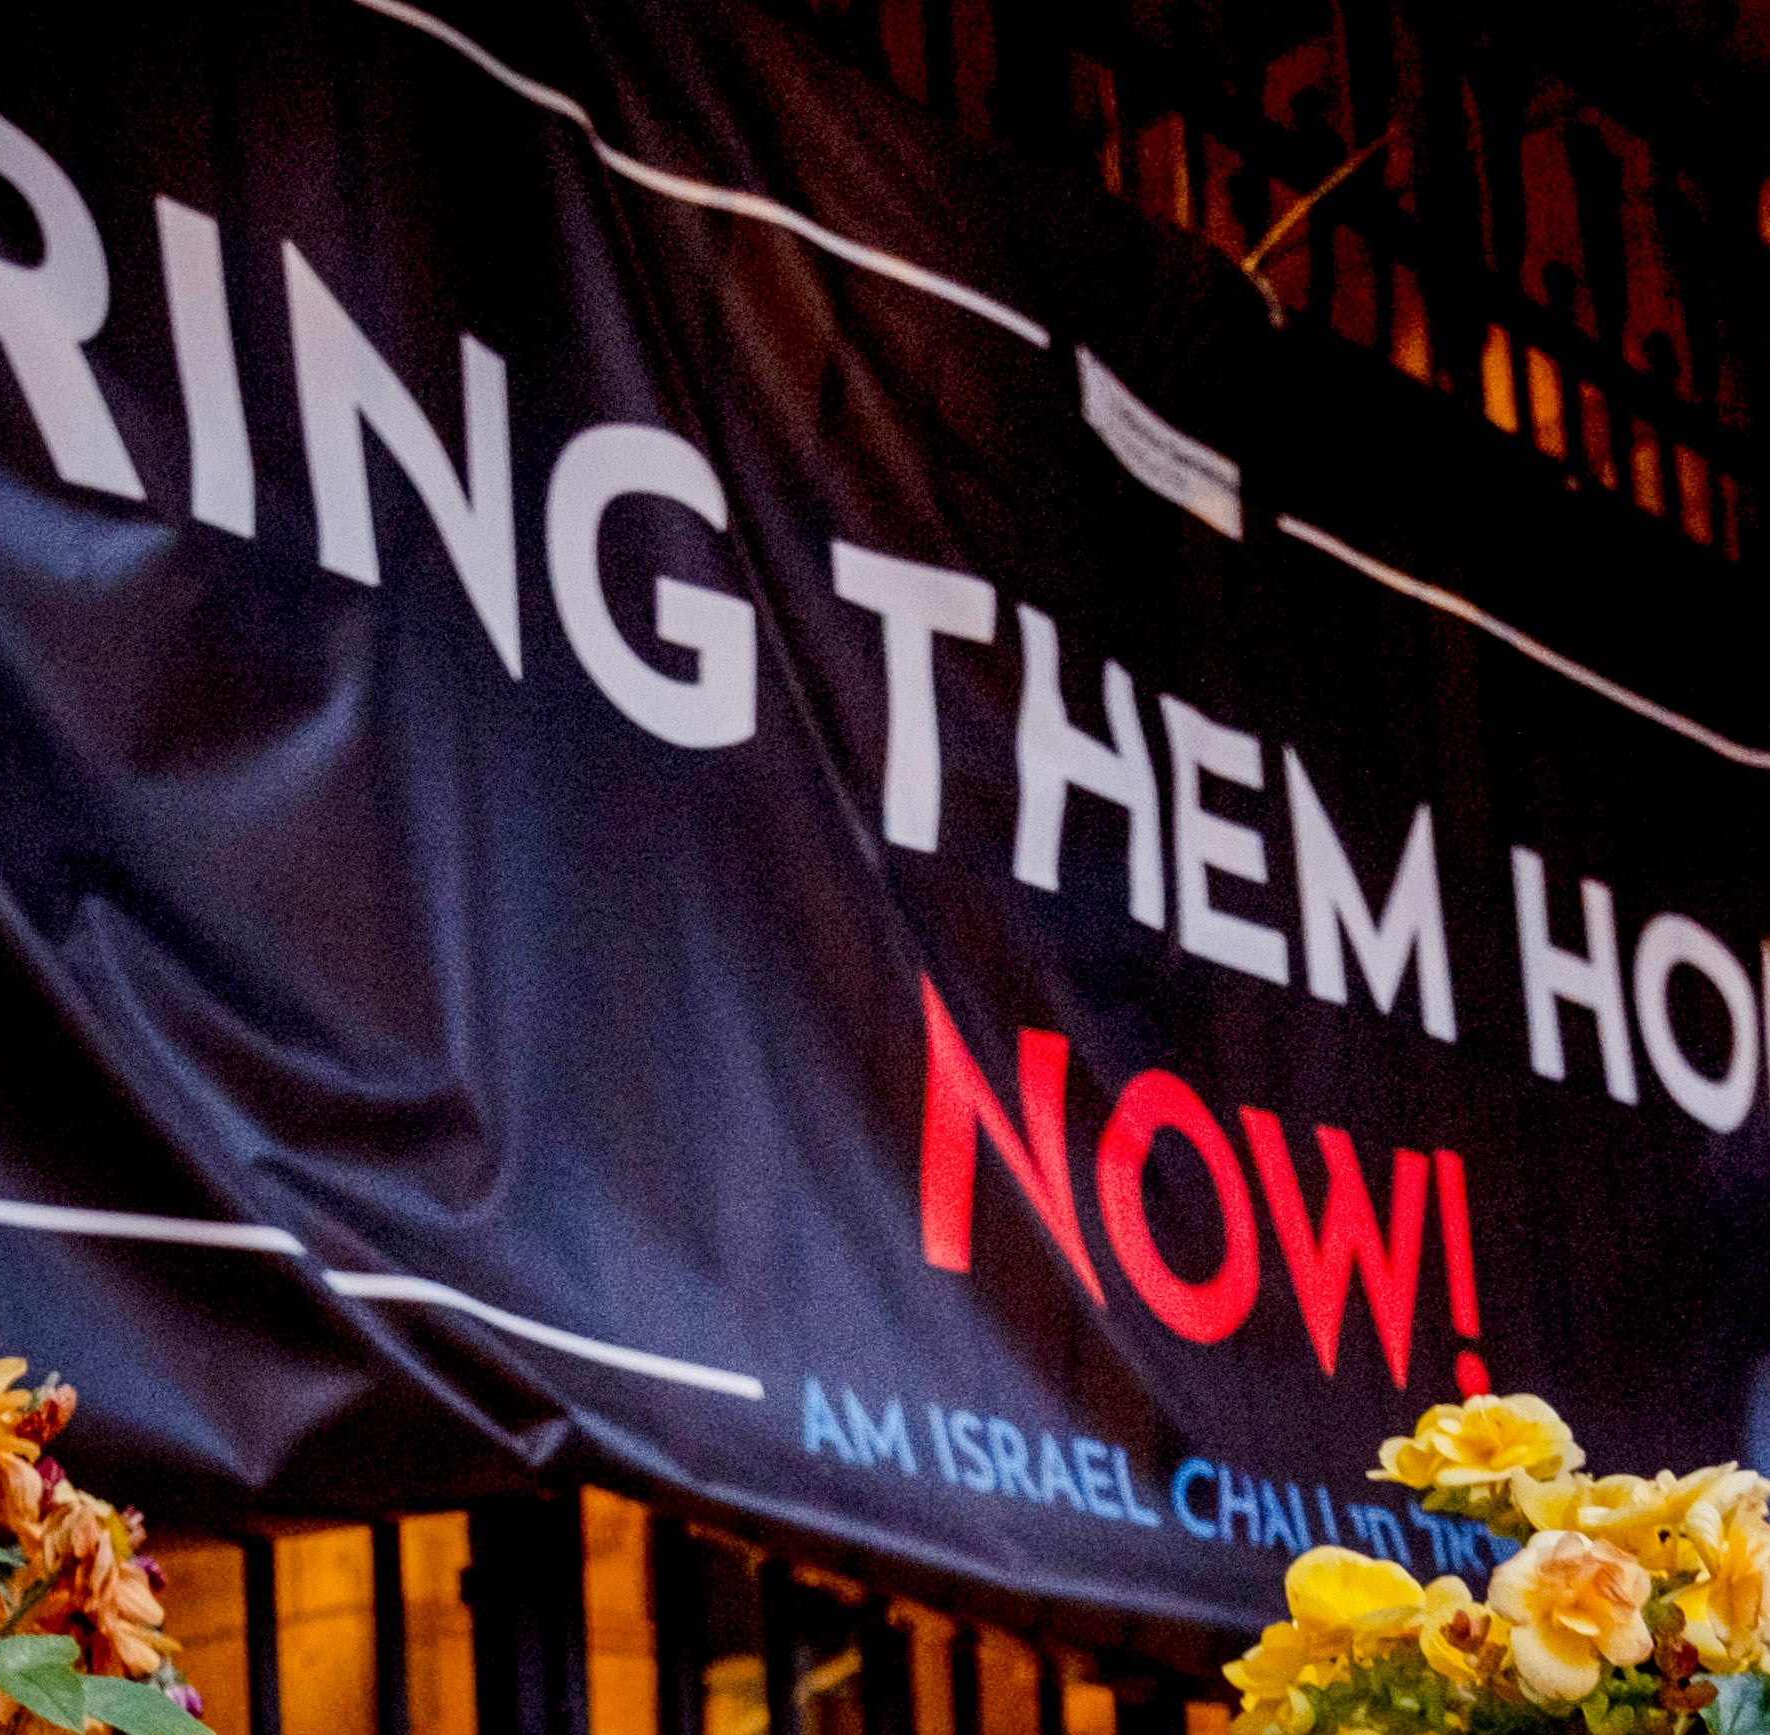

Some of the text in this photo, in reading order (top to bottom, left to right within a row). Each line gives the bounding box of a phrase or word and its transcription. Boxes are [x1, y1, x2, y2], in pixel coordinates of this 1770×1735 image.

[830, 540, 1457, 1045] THEM
[920, 972, 1490, 1398] NOW!
[802, 1377, 914, 1478] AM
[928, 1402, 1162, 1528] ISRAEL
